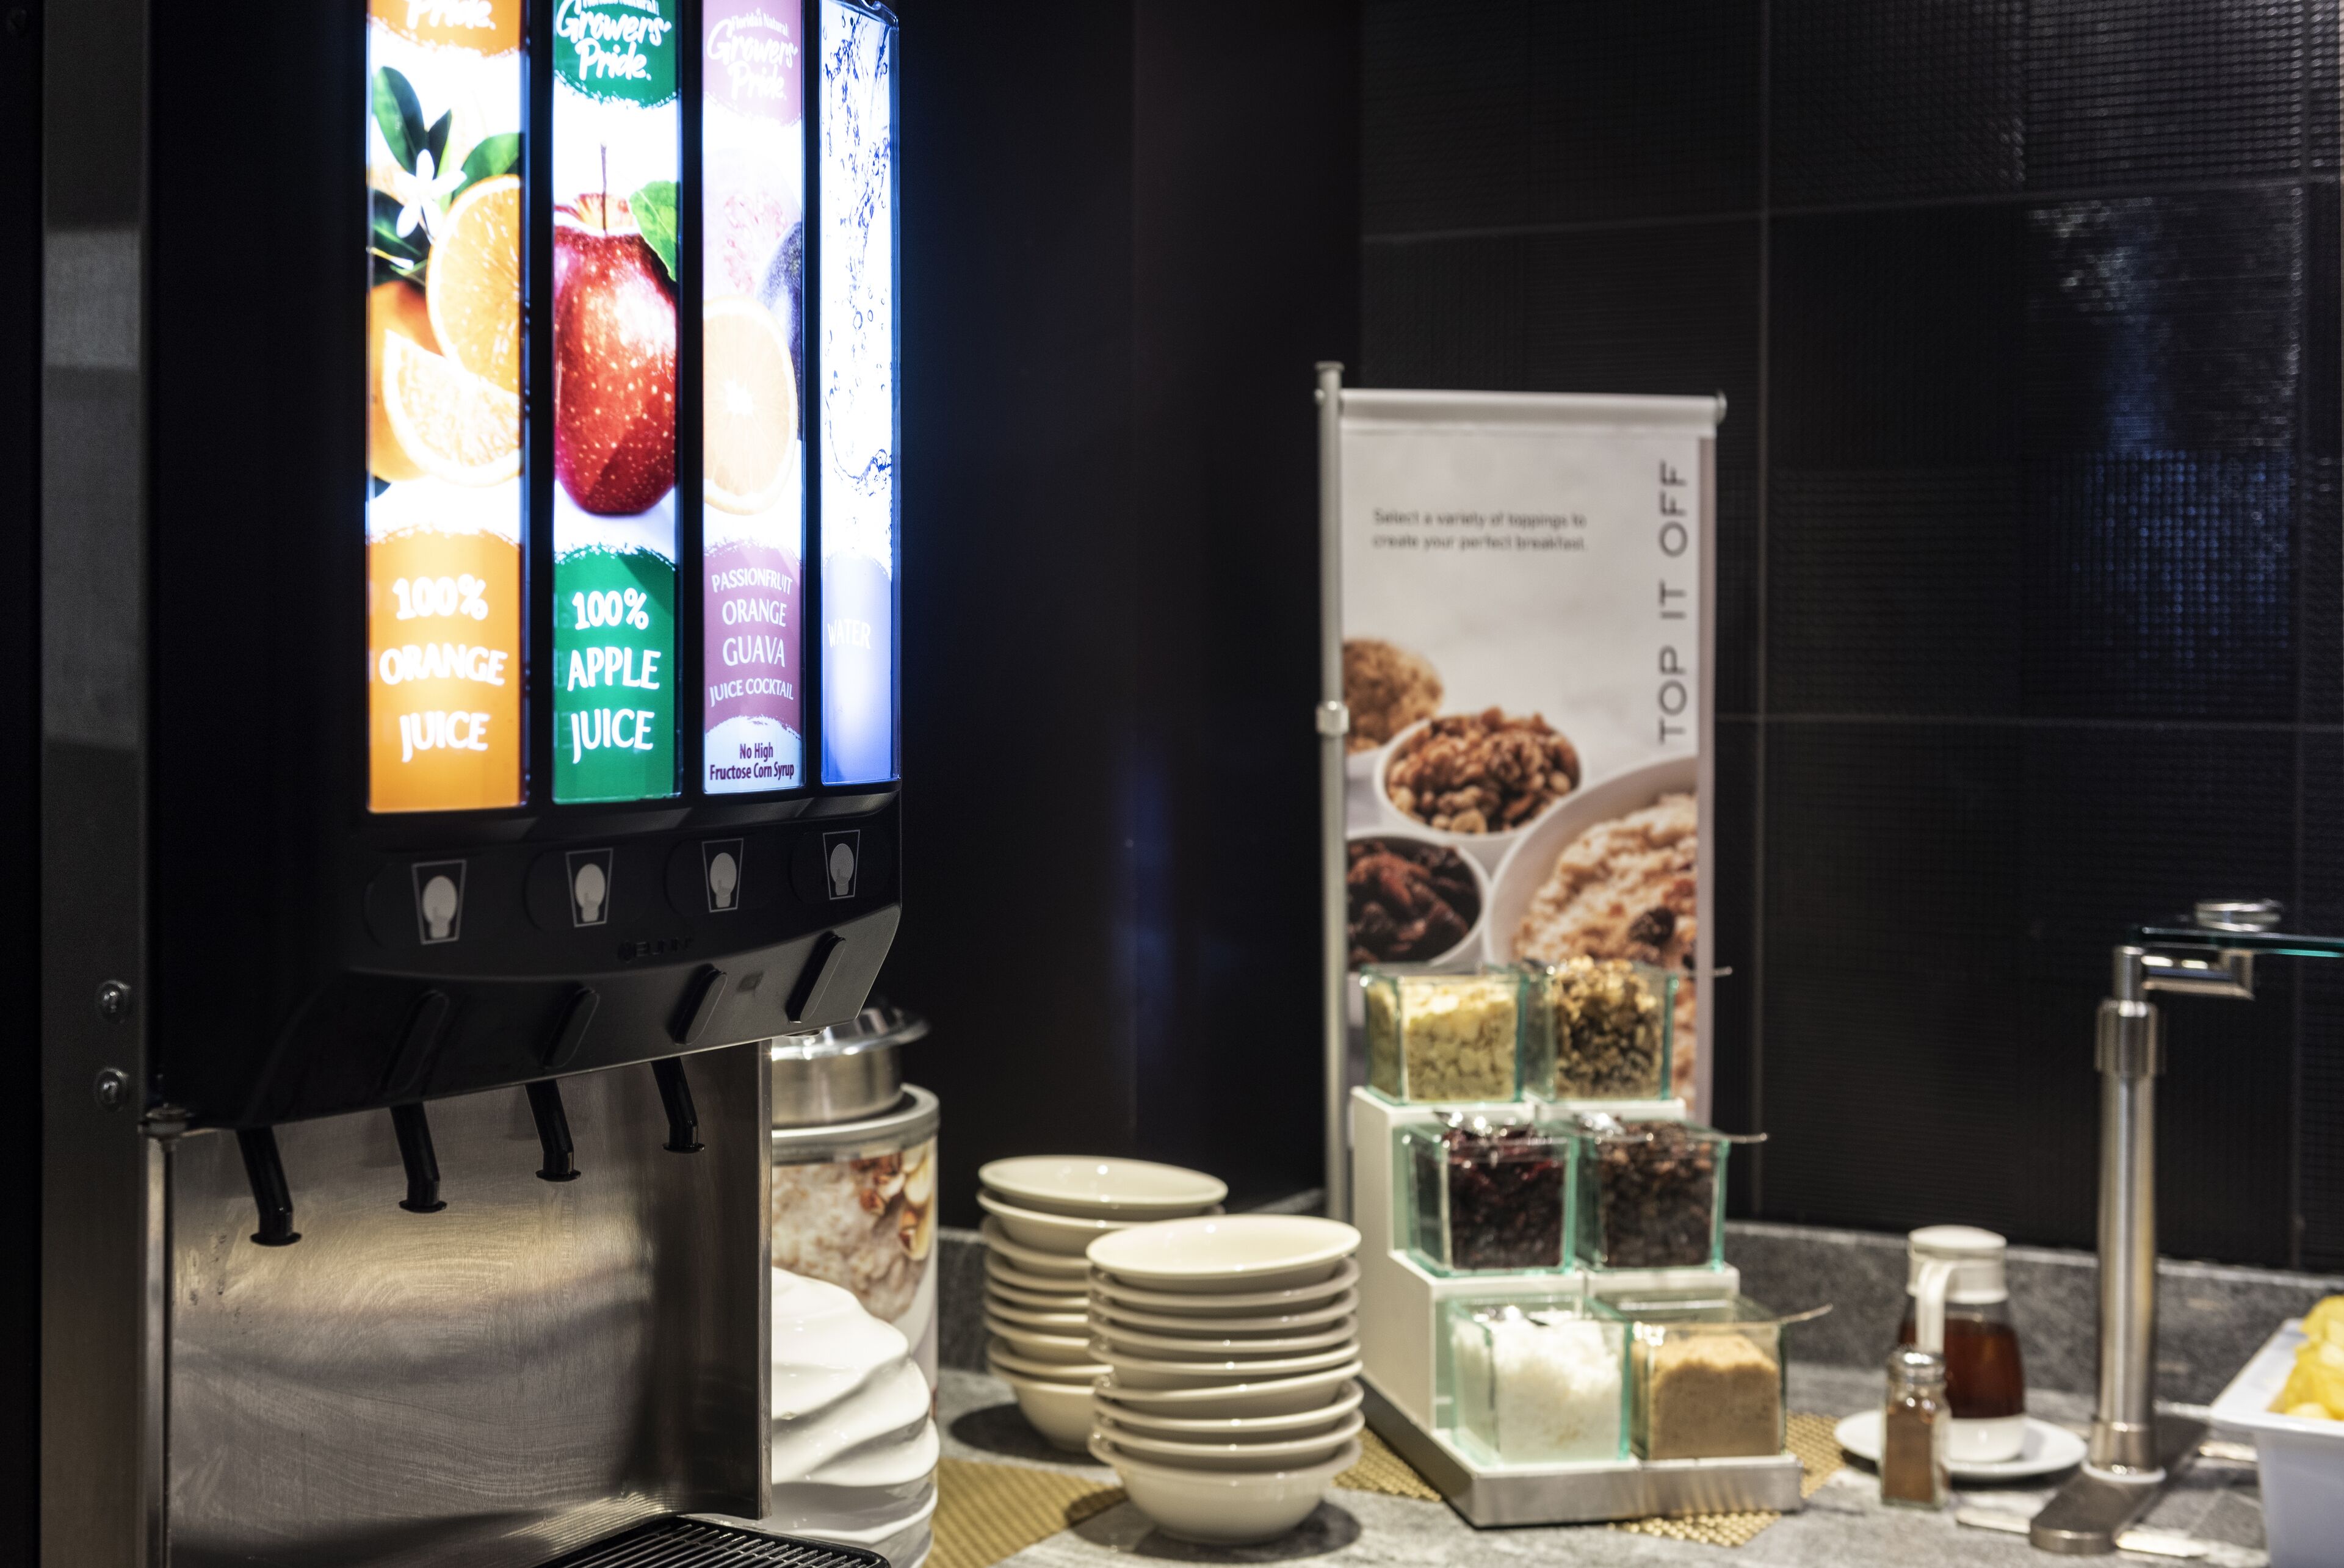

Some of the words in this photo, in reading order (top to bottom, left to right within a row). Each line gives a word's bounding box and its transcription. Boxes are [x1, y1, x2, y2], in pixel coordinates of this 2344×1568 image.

[1372, 508, 1419, 526] Select
[1423, 511, 1433, 526] a
[1436, 510, 1485, 530] variety
[1489, 510, 1505, 526] of
[1508, 511, 1568, 531] toppings
[1571, 512, 1587, 527] to
[1658, 459, 1688, 558] OFF
[1371, 534, 1419, 549] create
[1423, 535, 1455, 552] your
[1460, 534, 1512, 552] perfect
[392, 574, 489, 621] 100%
[711, 568, 793, 595] PASSIONFRUIT
[1659, 579, 1687, 620] IT
[572, 587, 649, 630] 100%
[722, 598, 787, 627] ORANGE
[722, 635, 786, 668] GUAVA
[827, 618, 871, 650] WATER
[378, 642, 508, 687] ORANGE
[567, 646, 662, 692] APPLE
[709, 679, 744, 708] JUICE
[745, 677, 794, 701] COCKTAIL
[1658, 644, 1687, 745] TOP
[399, 710, 491, 764] JUICE
[571, 708, 655, 764] JUICE
[739, 743, 752, 759] No
[754, 742, 773, 762] High
[710, 764, 751, 781] Fructose
[753, 762, 772, 778] Corn
[774, 762, 795, 781] Syrup
